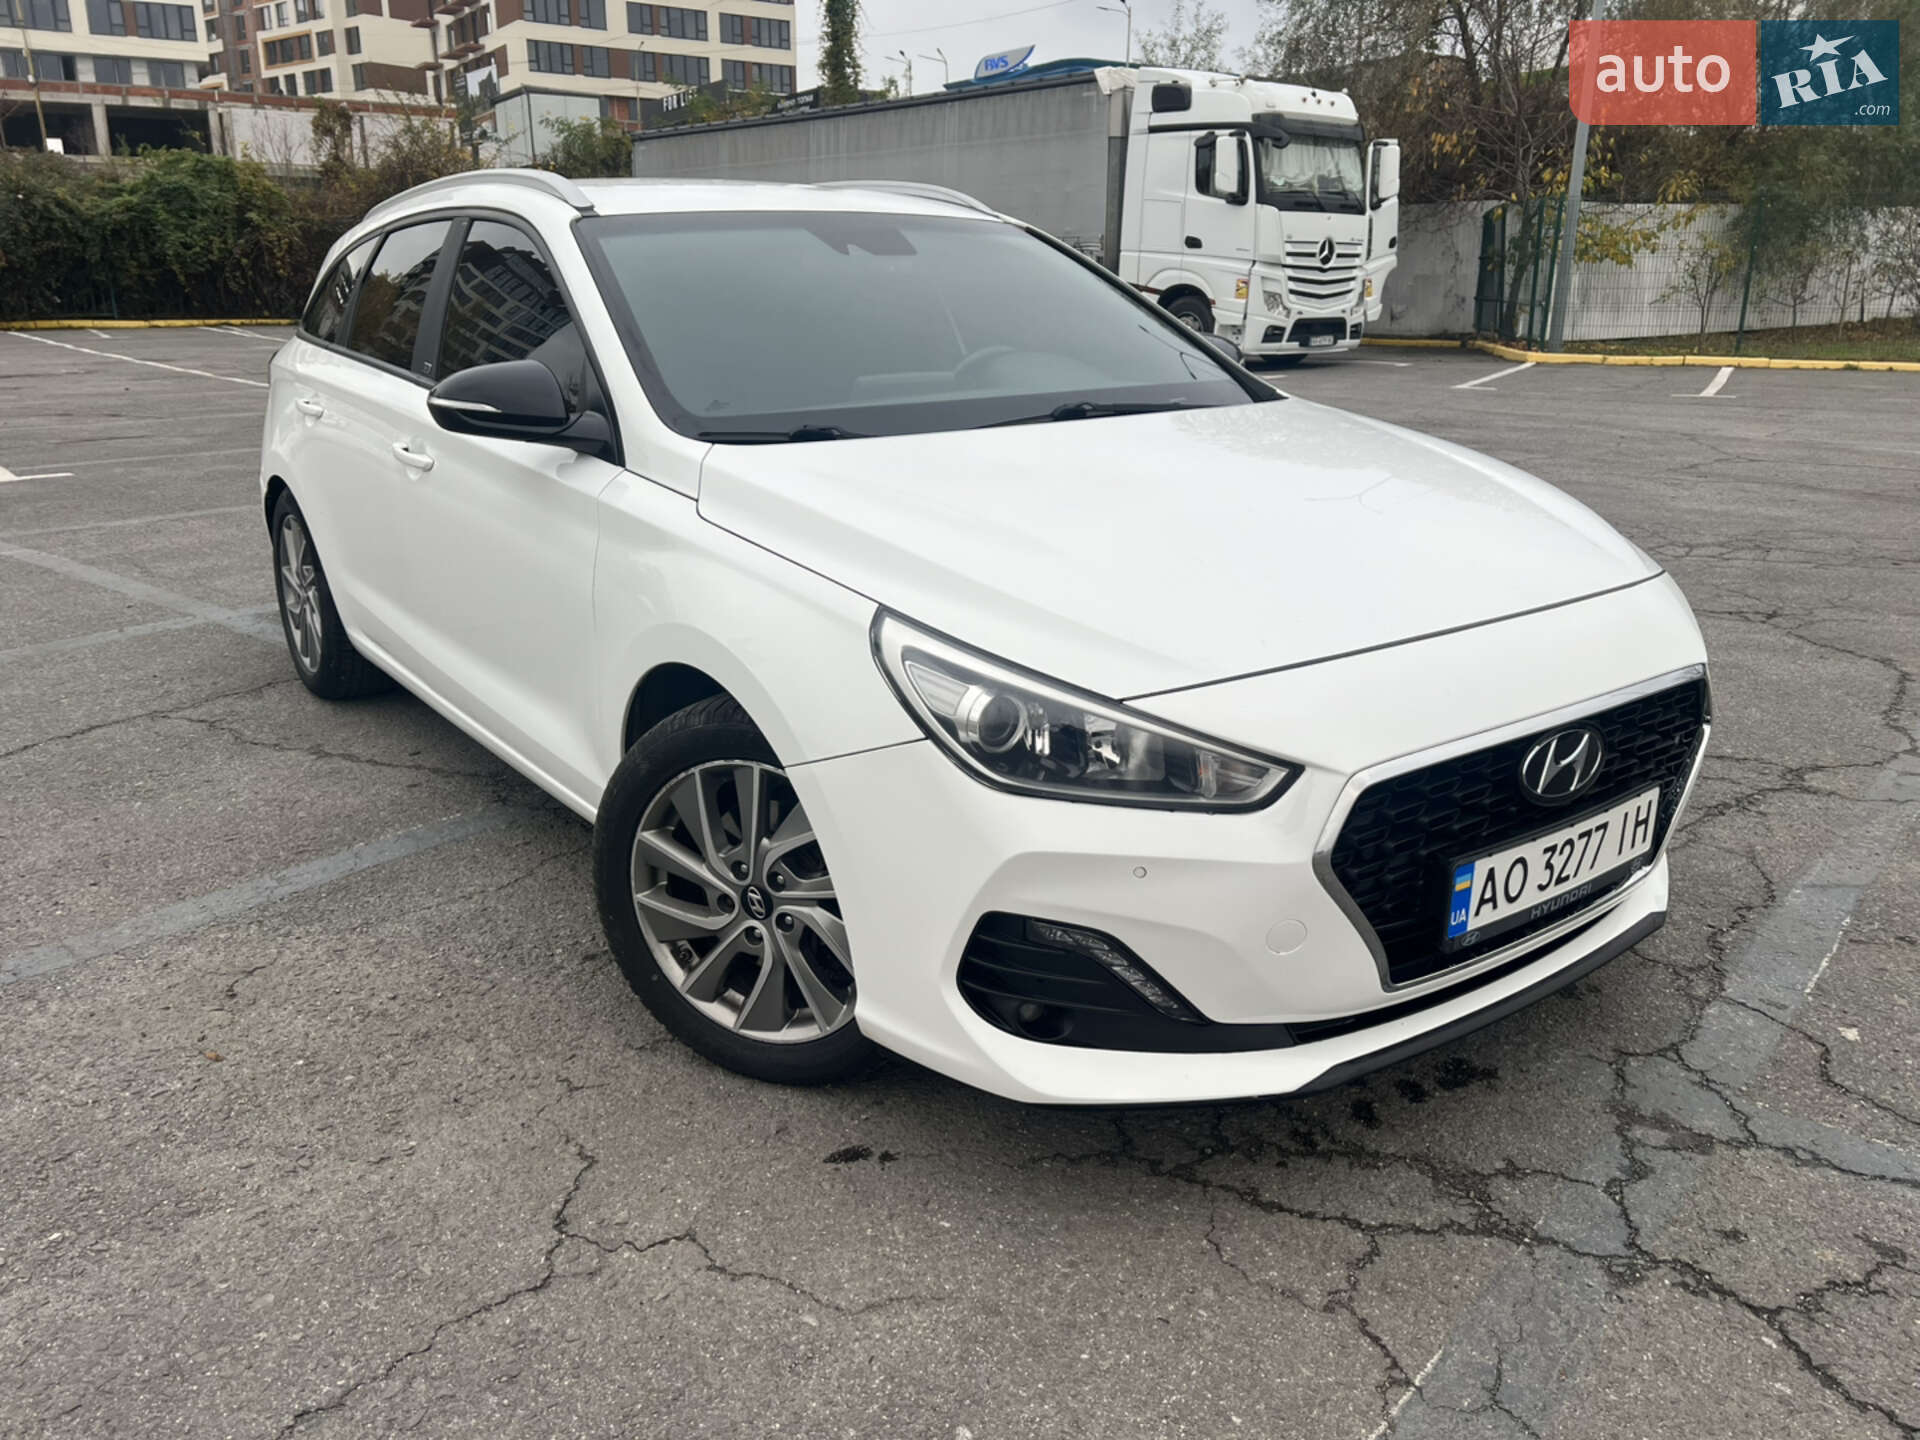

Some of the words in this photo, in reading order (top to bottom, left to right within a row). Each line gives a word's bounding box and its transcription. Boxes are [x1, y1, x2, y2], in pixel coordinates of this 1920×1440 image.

[1537, 821, 1609, 891] 3277
[1451, 909, 1467, 925] UA
[1530, 883, 1592, 919] HYUNDAI
